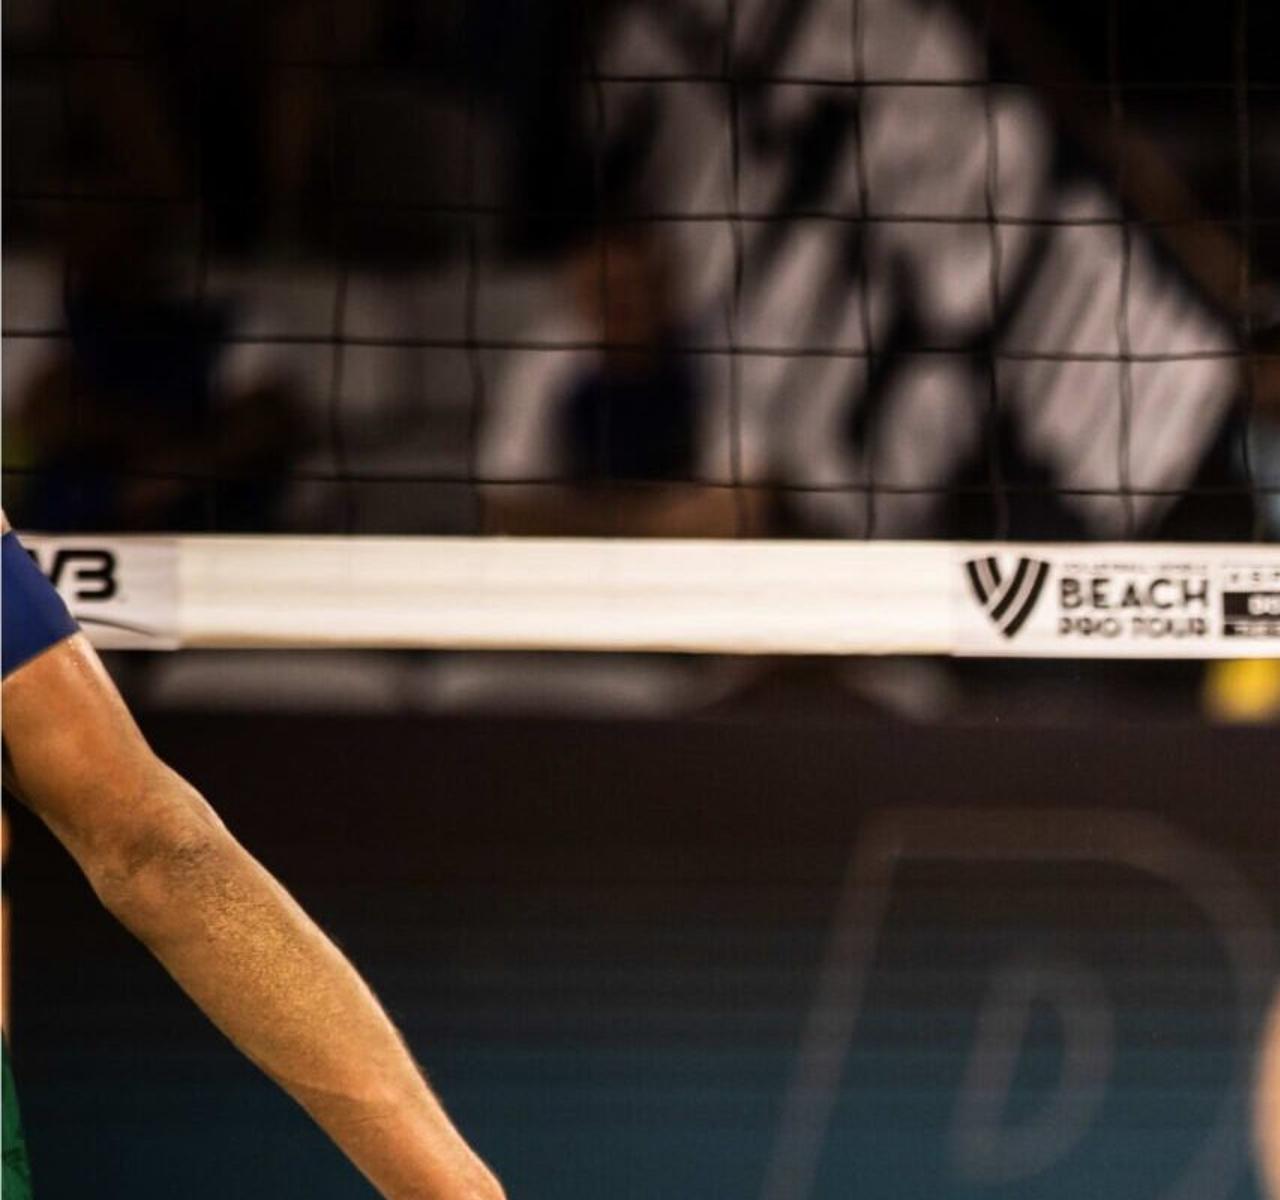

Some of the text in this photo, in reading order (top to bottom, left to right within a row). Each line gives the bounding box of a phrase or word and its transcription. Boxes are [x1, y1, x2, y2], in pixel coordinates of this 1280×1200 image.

[1060, 577, 1210, 609] BEACH
[1058, 617, 1206, 638] PRO TOUR
